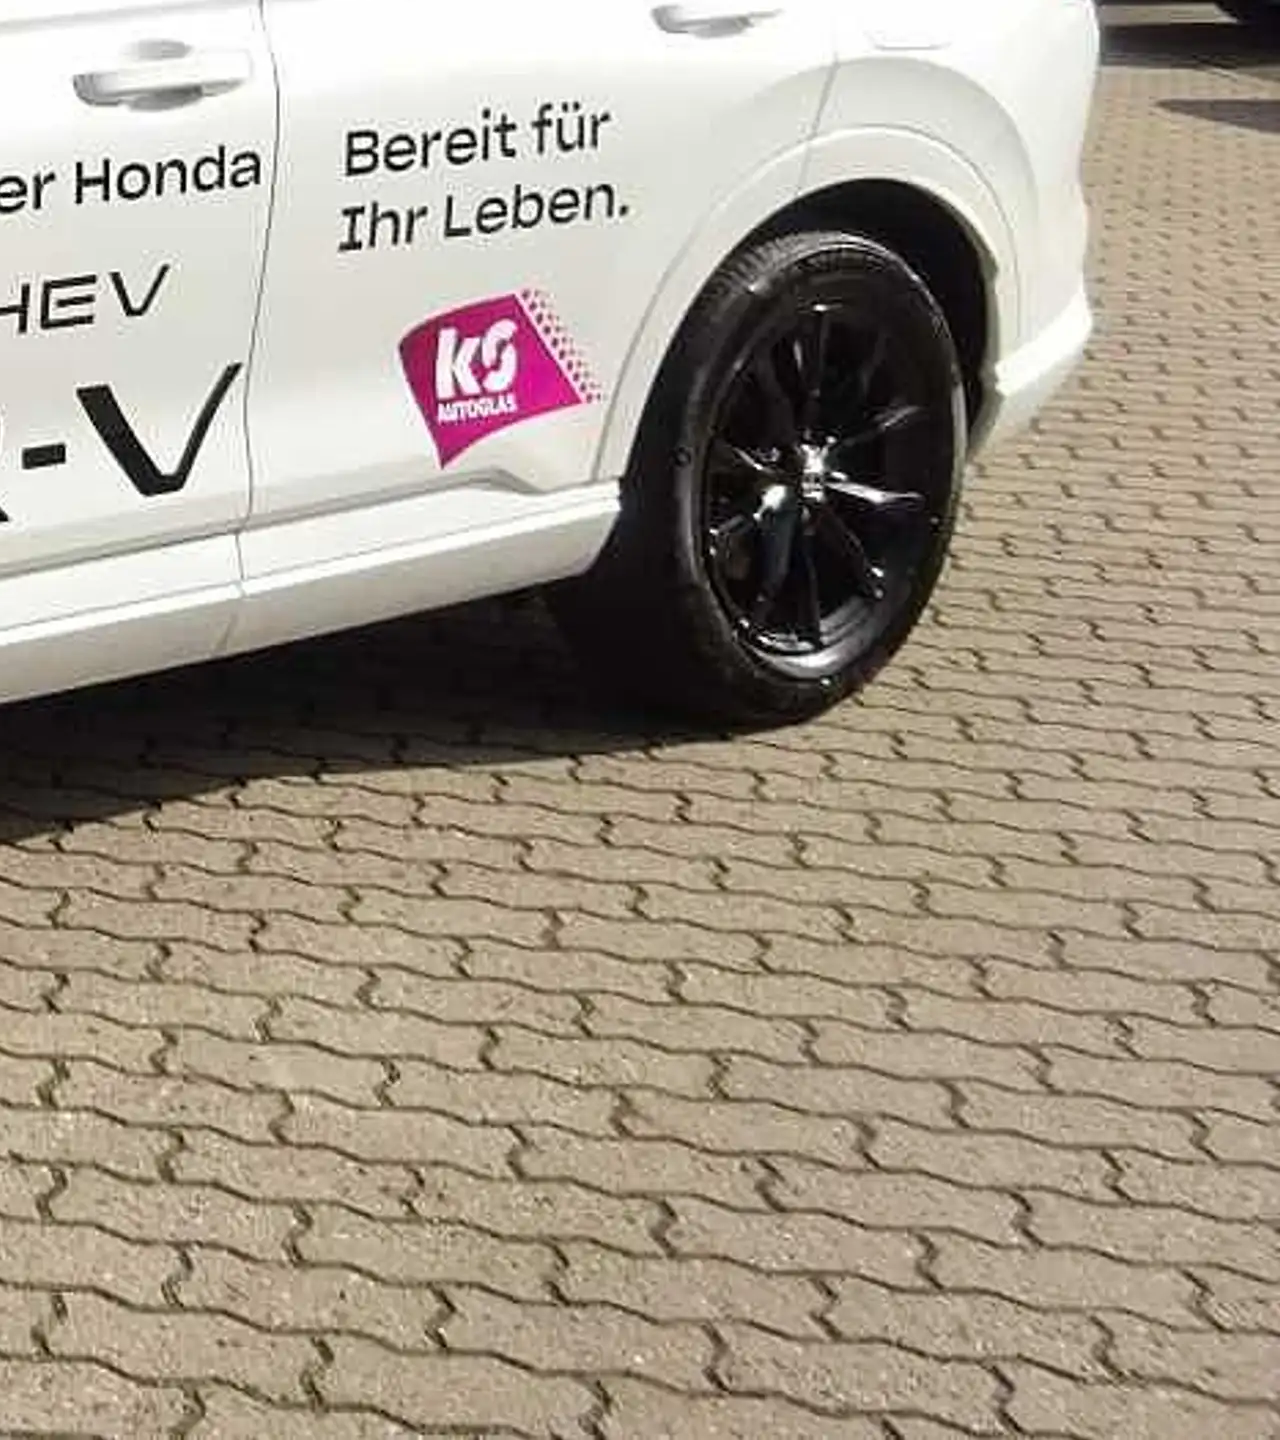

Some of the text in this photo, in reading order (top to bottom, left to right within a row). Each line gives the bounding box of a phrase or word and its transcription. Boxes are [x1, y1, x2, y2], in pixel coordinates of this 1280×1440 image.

[73, 144, 264, 206] Honda
[344, 100, 613, 178] Bereit für
[337, 181, 632, 253] Ihr Leben.
